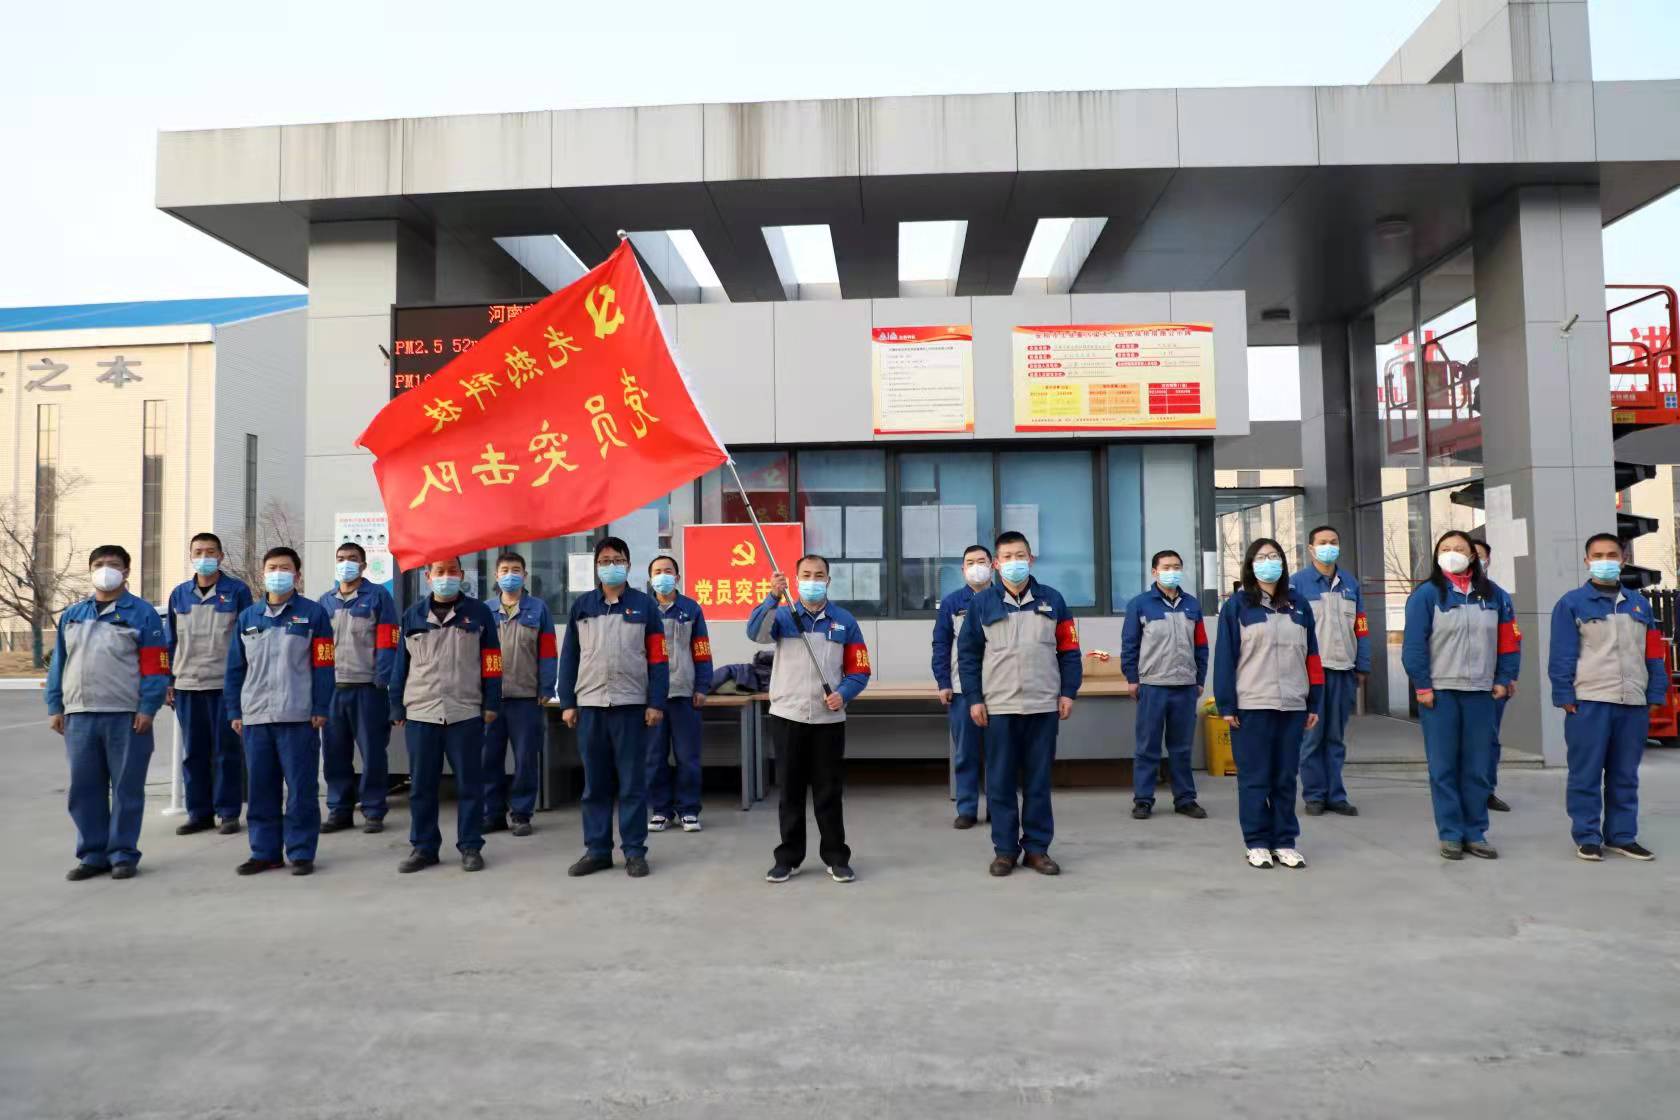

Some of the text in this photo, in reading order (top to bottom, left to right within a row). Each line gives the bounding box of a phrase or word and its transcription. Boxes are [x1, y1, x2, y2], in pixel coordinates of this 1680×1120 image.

[488, 304, 534, 323] 河南
[395, 339, 443, 355] PM2.5
[0, 355, 144, 392] 之本
